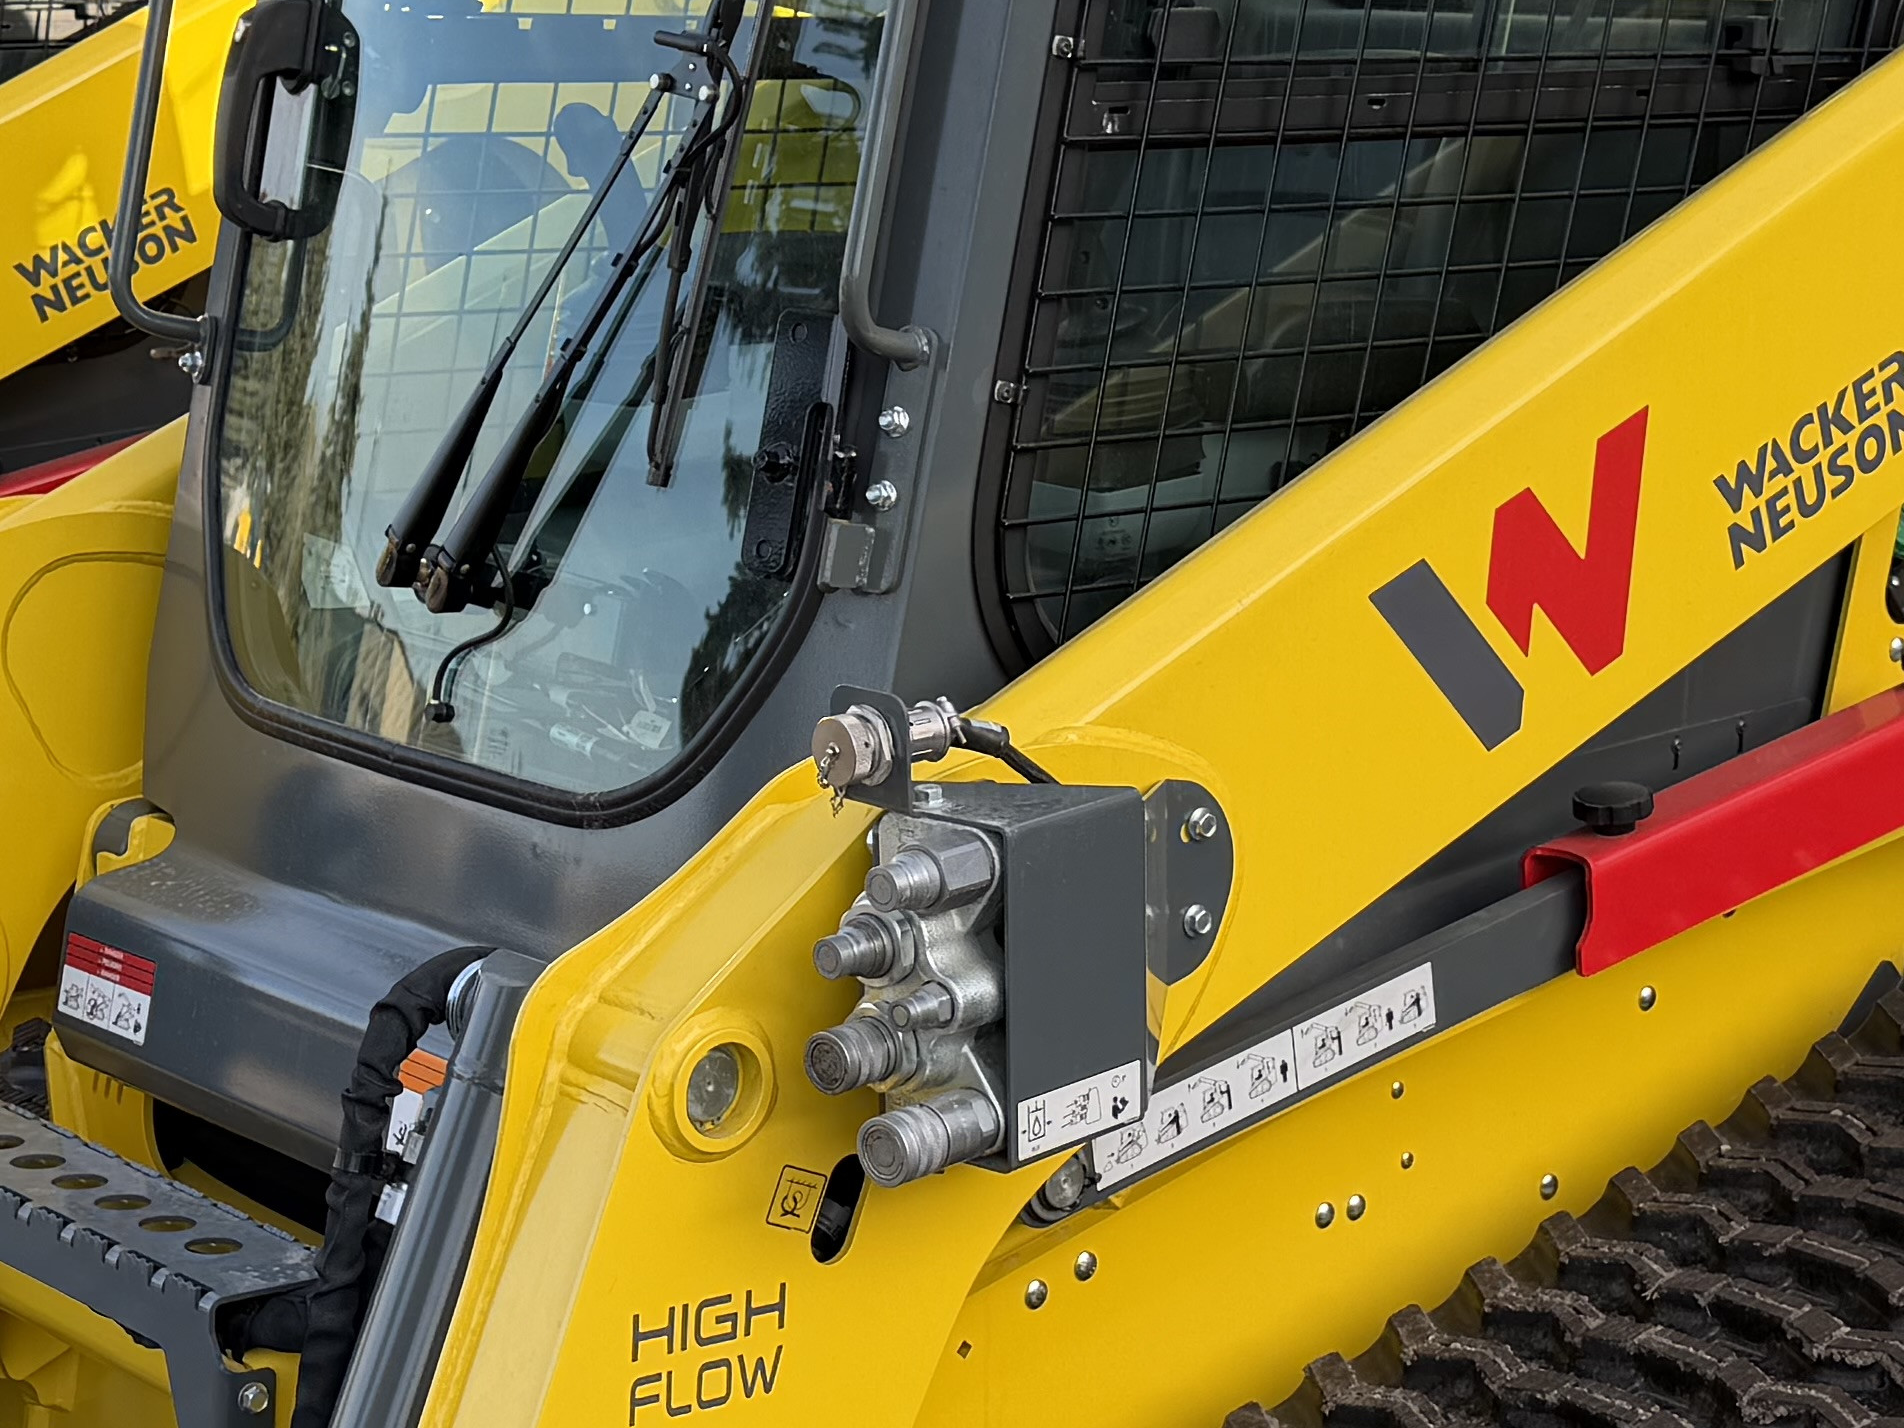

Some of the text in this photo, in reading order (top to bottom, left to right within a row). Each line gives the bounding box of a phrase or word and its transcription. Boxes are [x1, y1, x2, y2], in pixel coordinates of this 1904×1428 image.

[30, 214, 198, 324] NEUON
[631, 1281, 787, 1363] HIGH
[628, 1344, 784, 1428] FLOW
